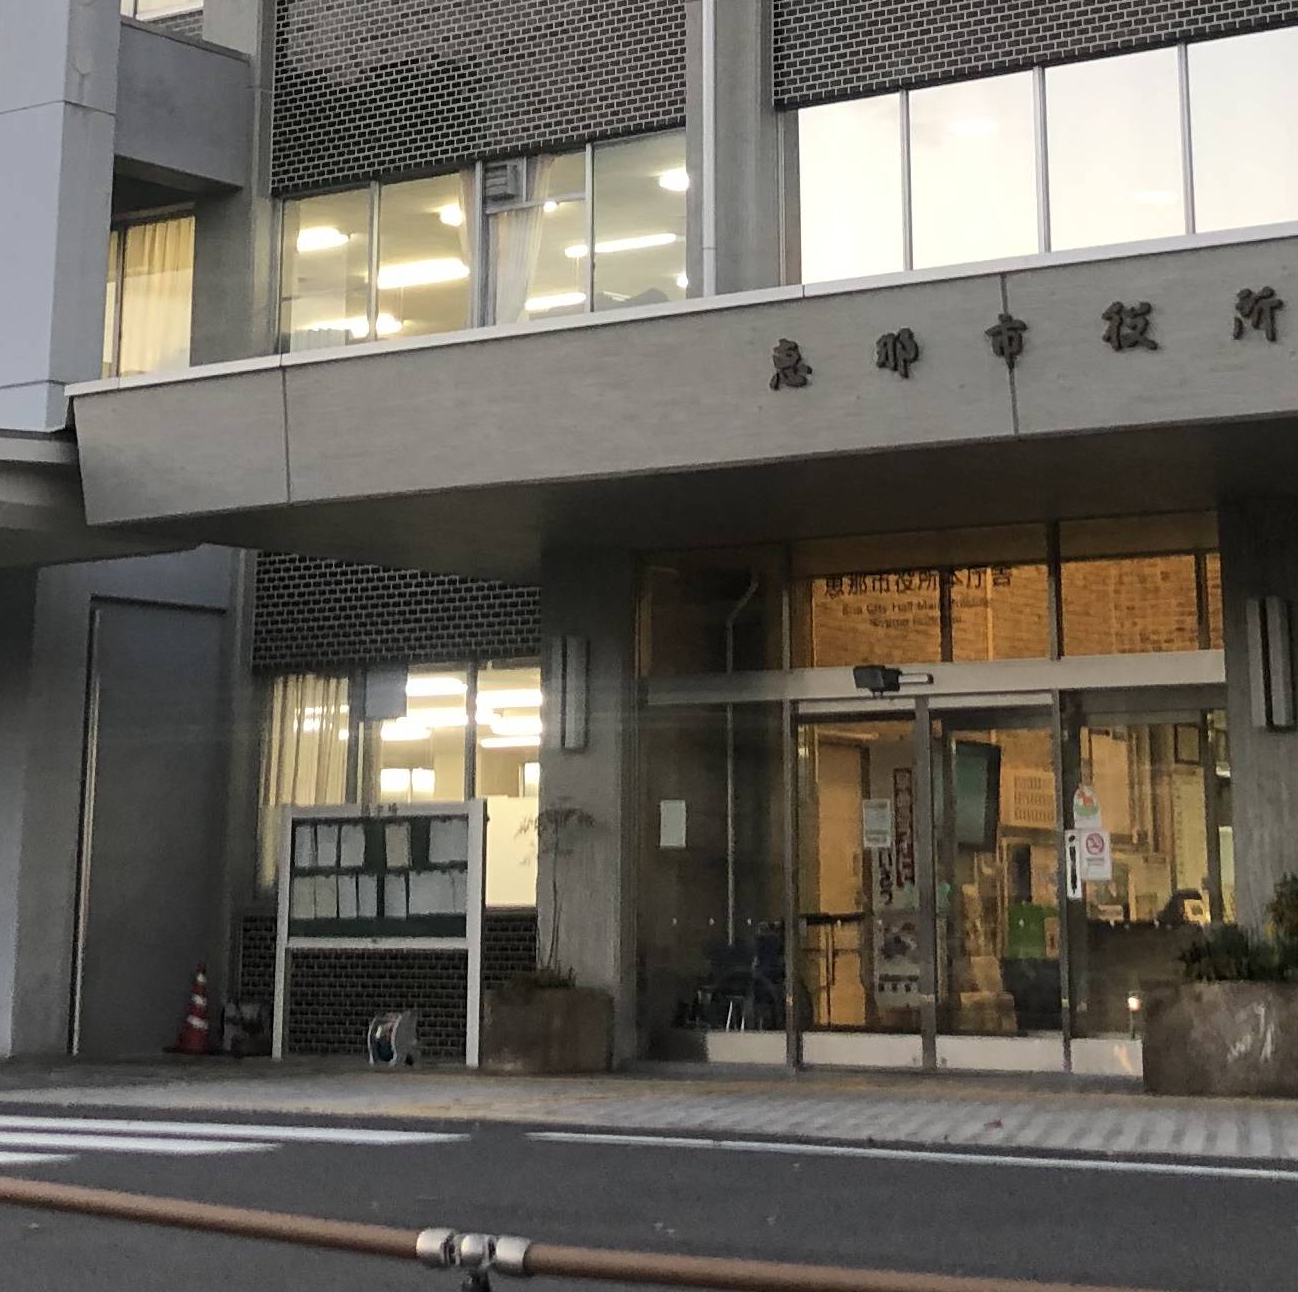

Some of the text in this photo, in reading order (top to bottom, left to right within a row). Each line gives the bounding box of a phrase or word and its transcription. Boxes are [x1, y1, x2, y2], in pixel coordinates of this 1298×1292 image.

[768, 285, 1285, 391] 恵那市役所
